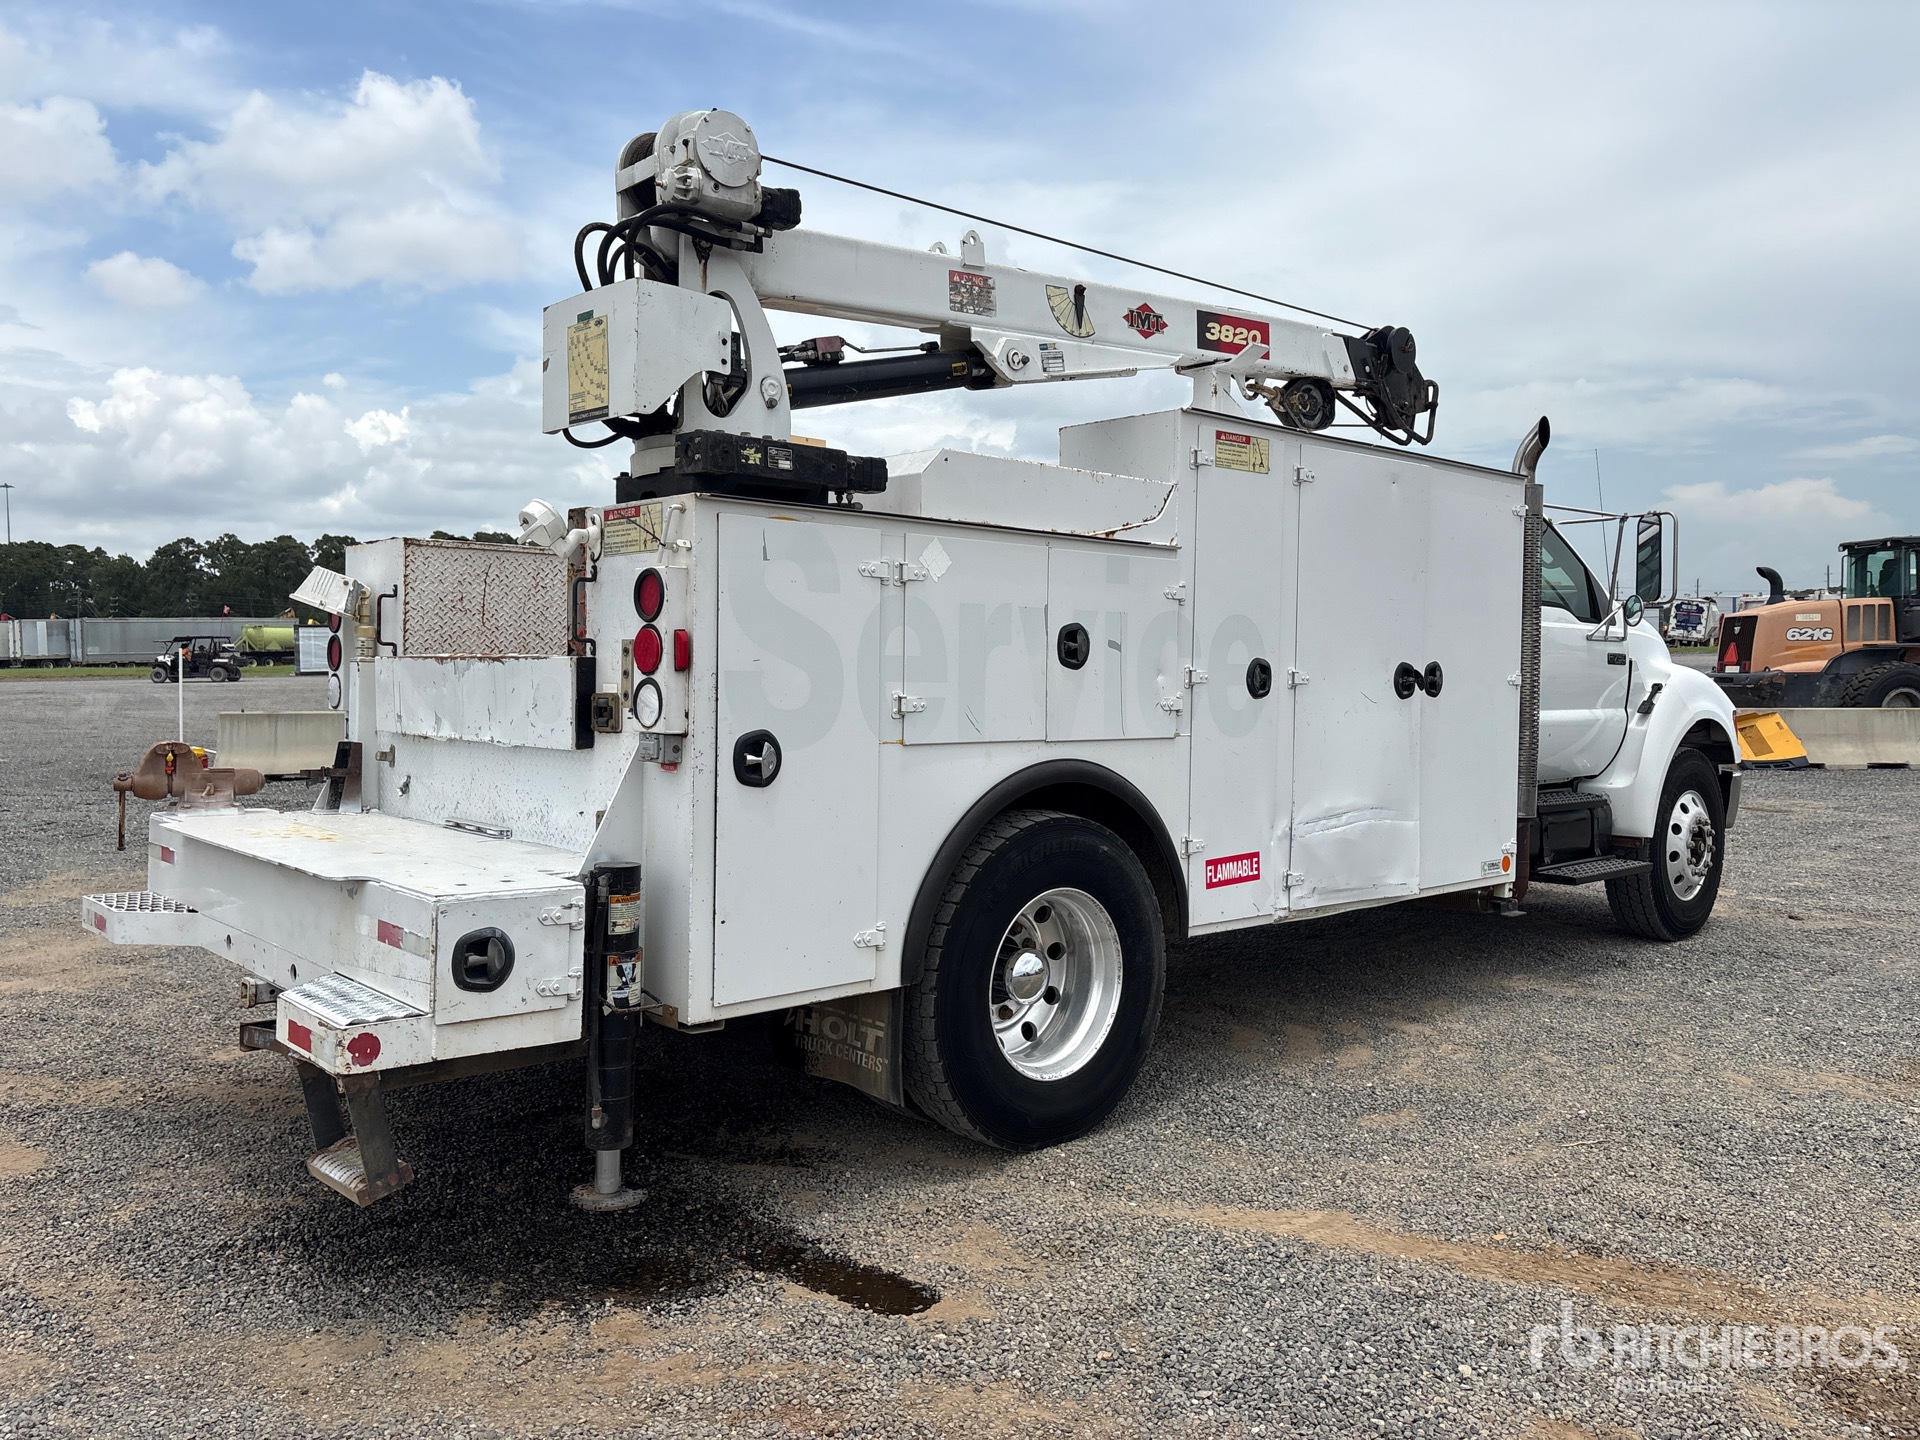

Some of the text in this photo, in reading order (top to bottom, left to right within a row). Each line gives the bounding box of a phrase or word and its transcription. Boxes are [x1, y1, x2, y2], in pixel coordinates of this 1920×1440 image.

[1127, 308, 1164, 333] IMT
[1205, 321, 1262, 346] 3820
[1225, 433, 1246, 443] DANGER
[723, 519, 1268, 750] Service
[1786, 627, 1834, 641] 621G
[1206, 857, 1259, 883] FLAMMABLE
[795, 1008, 884, 1053] HOLT
[795, 1033, 833, 1055] TRUCK
